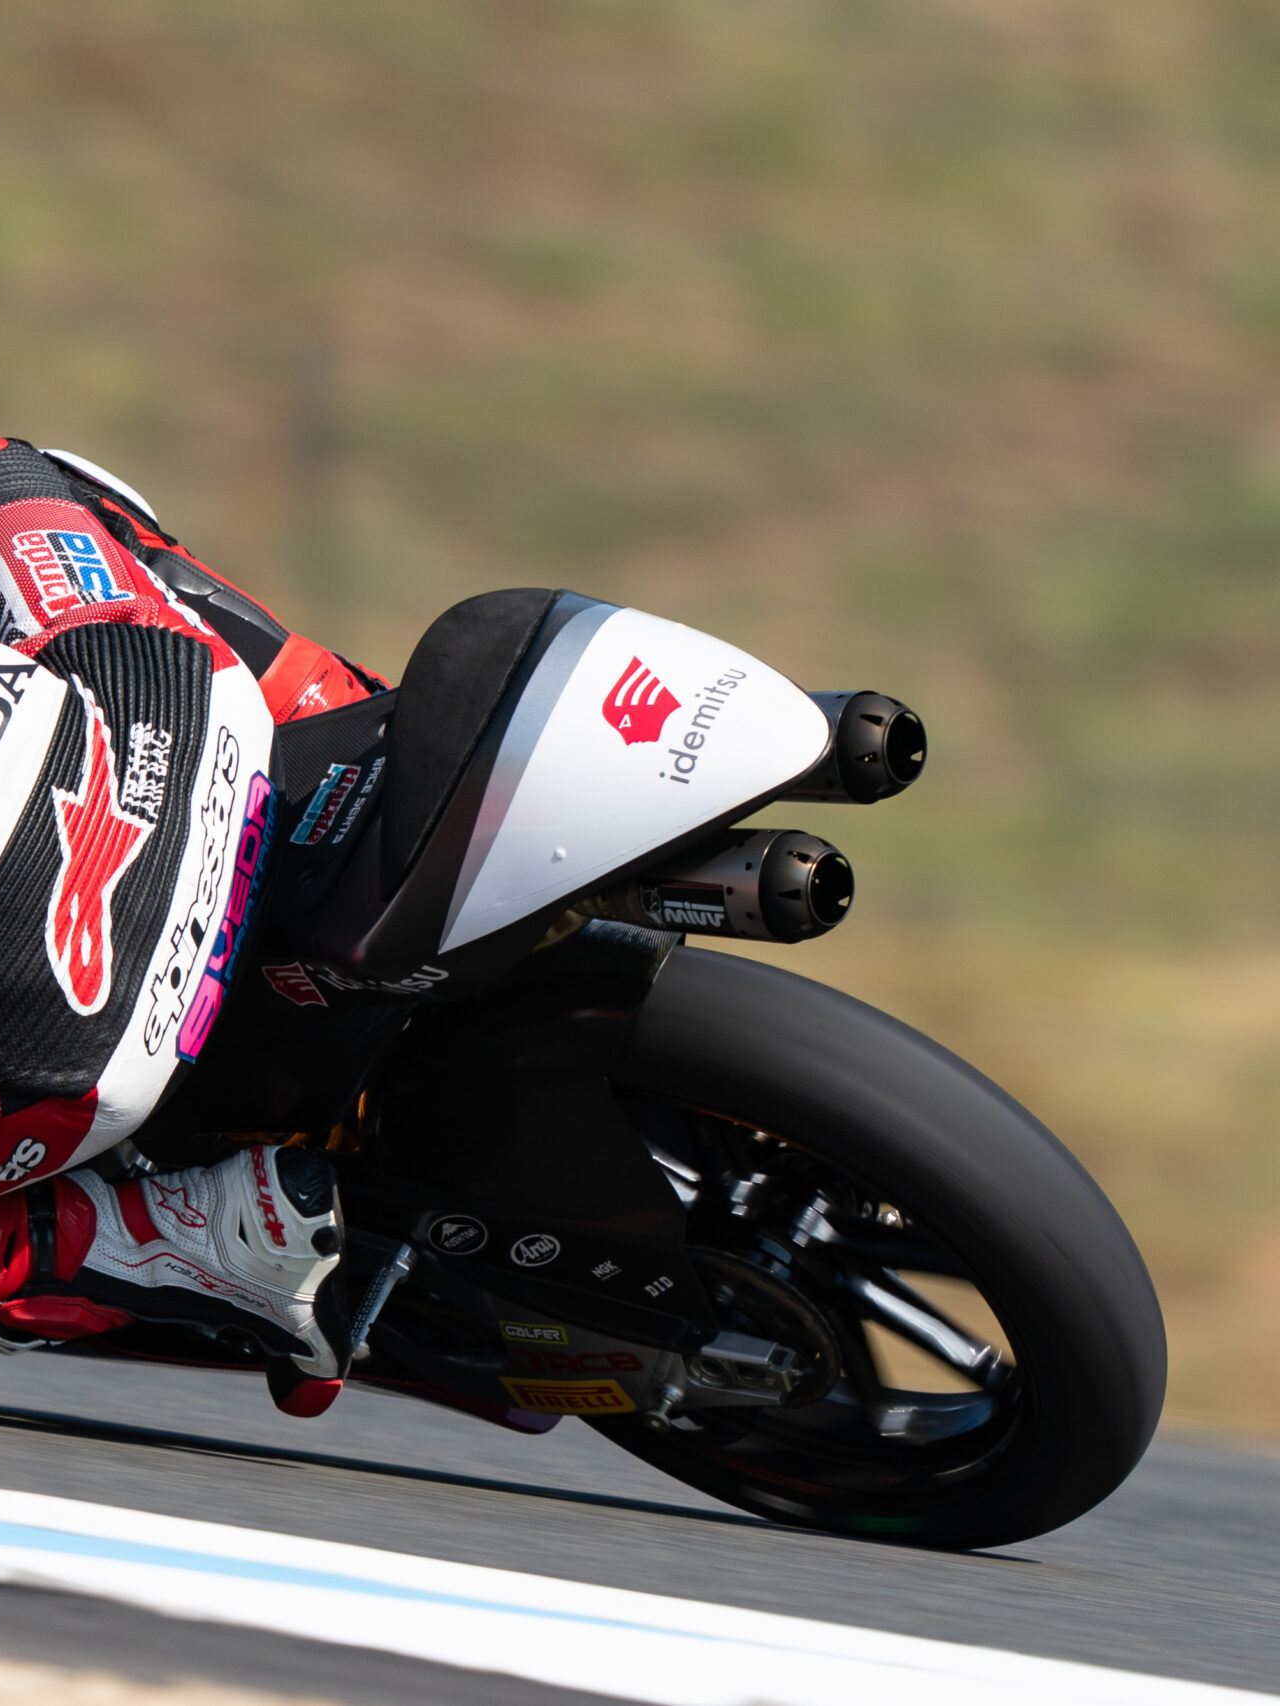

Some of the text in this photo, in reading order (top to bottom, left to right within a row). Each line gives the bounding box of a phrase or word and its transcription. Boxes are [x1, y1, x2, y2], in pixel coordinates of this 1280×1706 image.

[659, 668, 747, 785] idemitsu
[144, 726, 239, 1056] alpinestars
[520, 1235, 554, 1265] Arai
[591, 1260, 618, 1278] NGK
[504, 1325, 562, 1341] GALFER
[513, 1384, 625, 1408] PIRELLI
